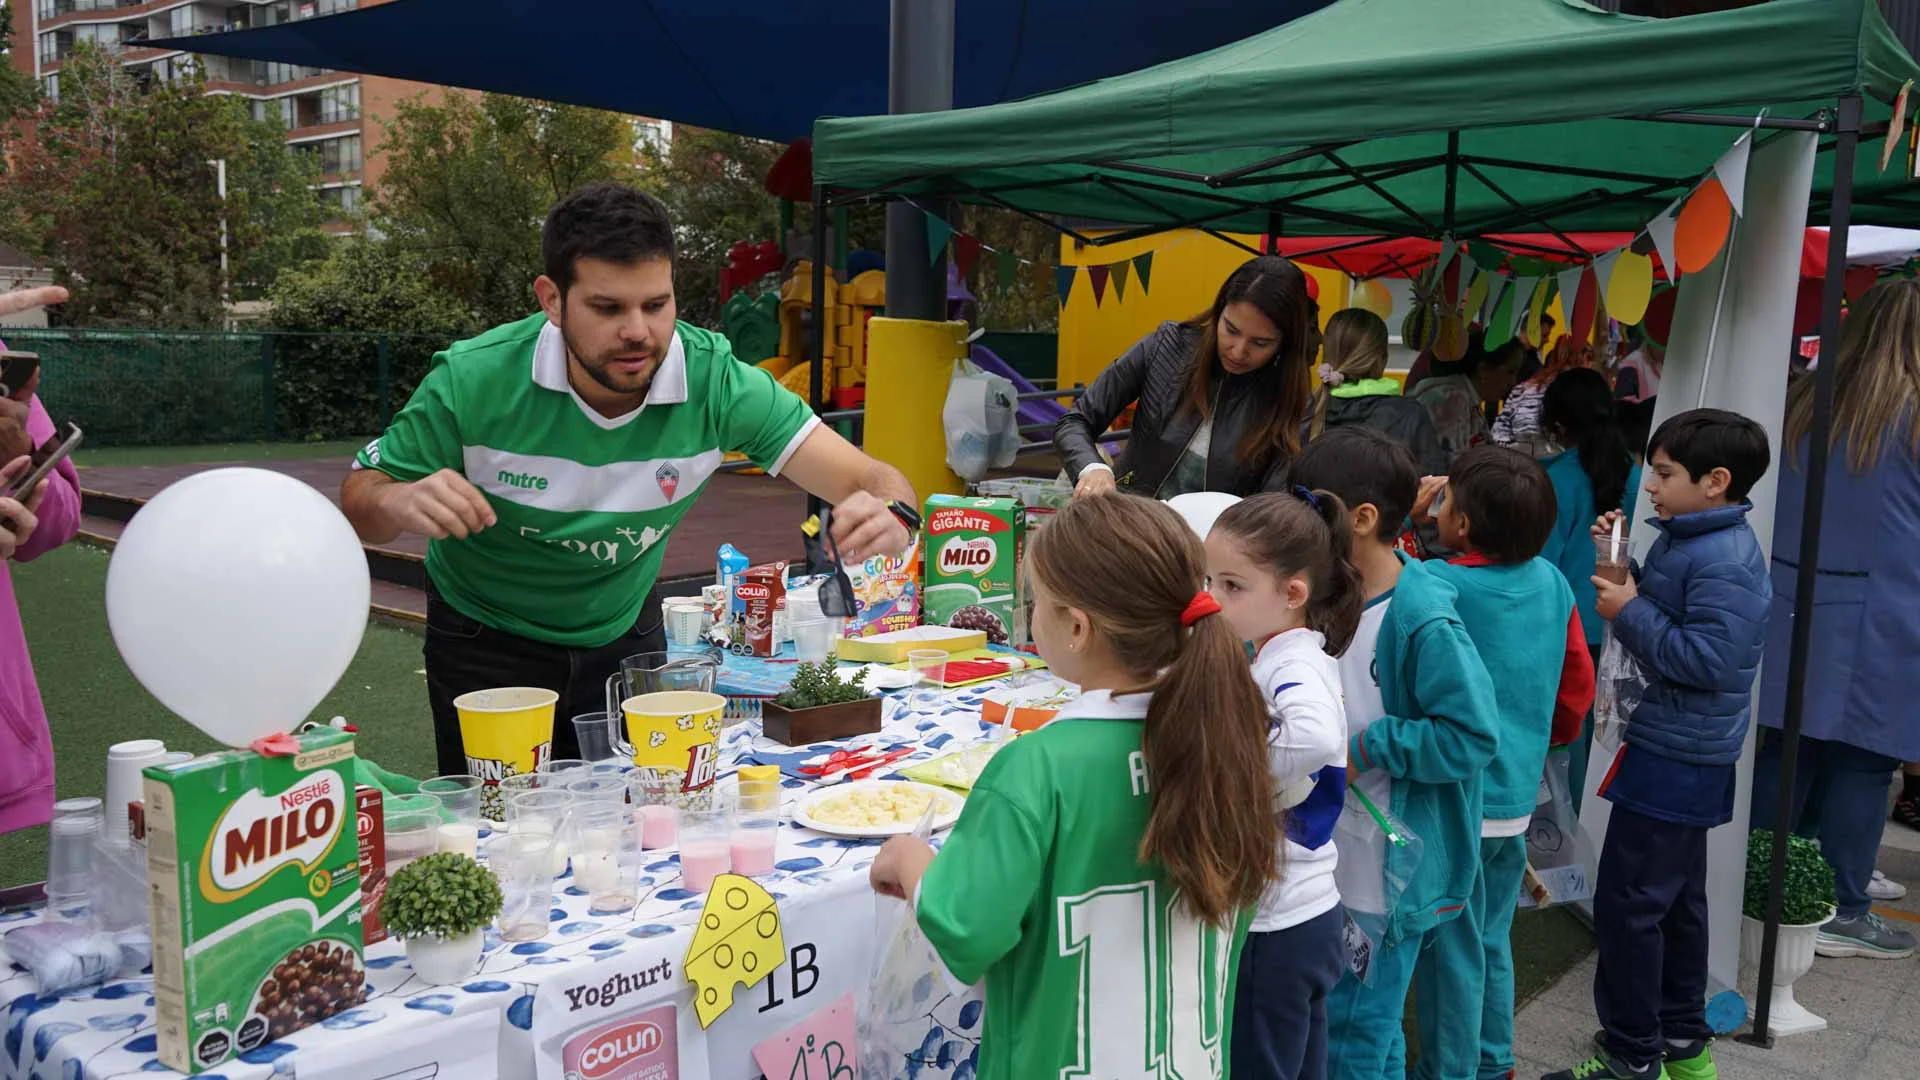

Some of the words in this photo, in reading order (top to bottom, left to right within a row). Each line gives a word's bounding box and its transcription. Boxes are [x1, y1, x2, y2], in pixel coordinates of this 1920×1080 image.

[498, 469, 548, 490] mitre
[932, 517, 991, 532] GIGANTE
[936, 509, 964, 519] TAMAÑO
[943, 548, 991, 566] MILO
[881, 615, 916, 625] SQUISHY
[224, 798, 335, 876] MILO
[564, 958, 672, 1012] Yoghurt
[1056, 880, 1240, 1080] 10
[582, 1027, 656, 1070] COLUN
